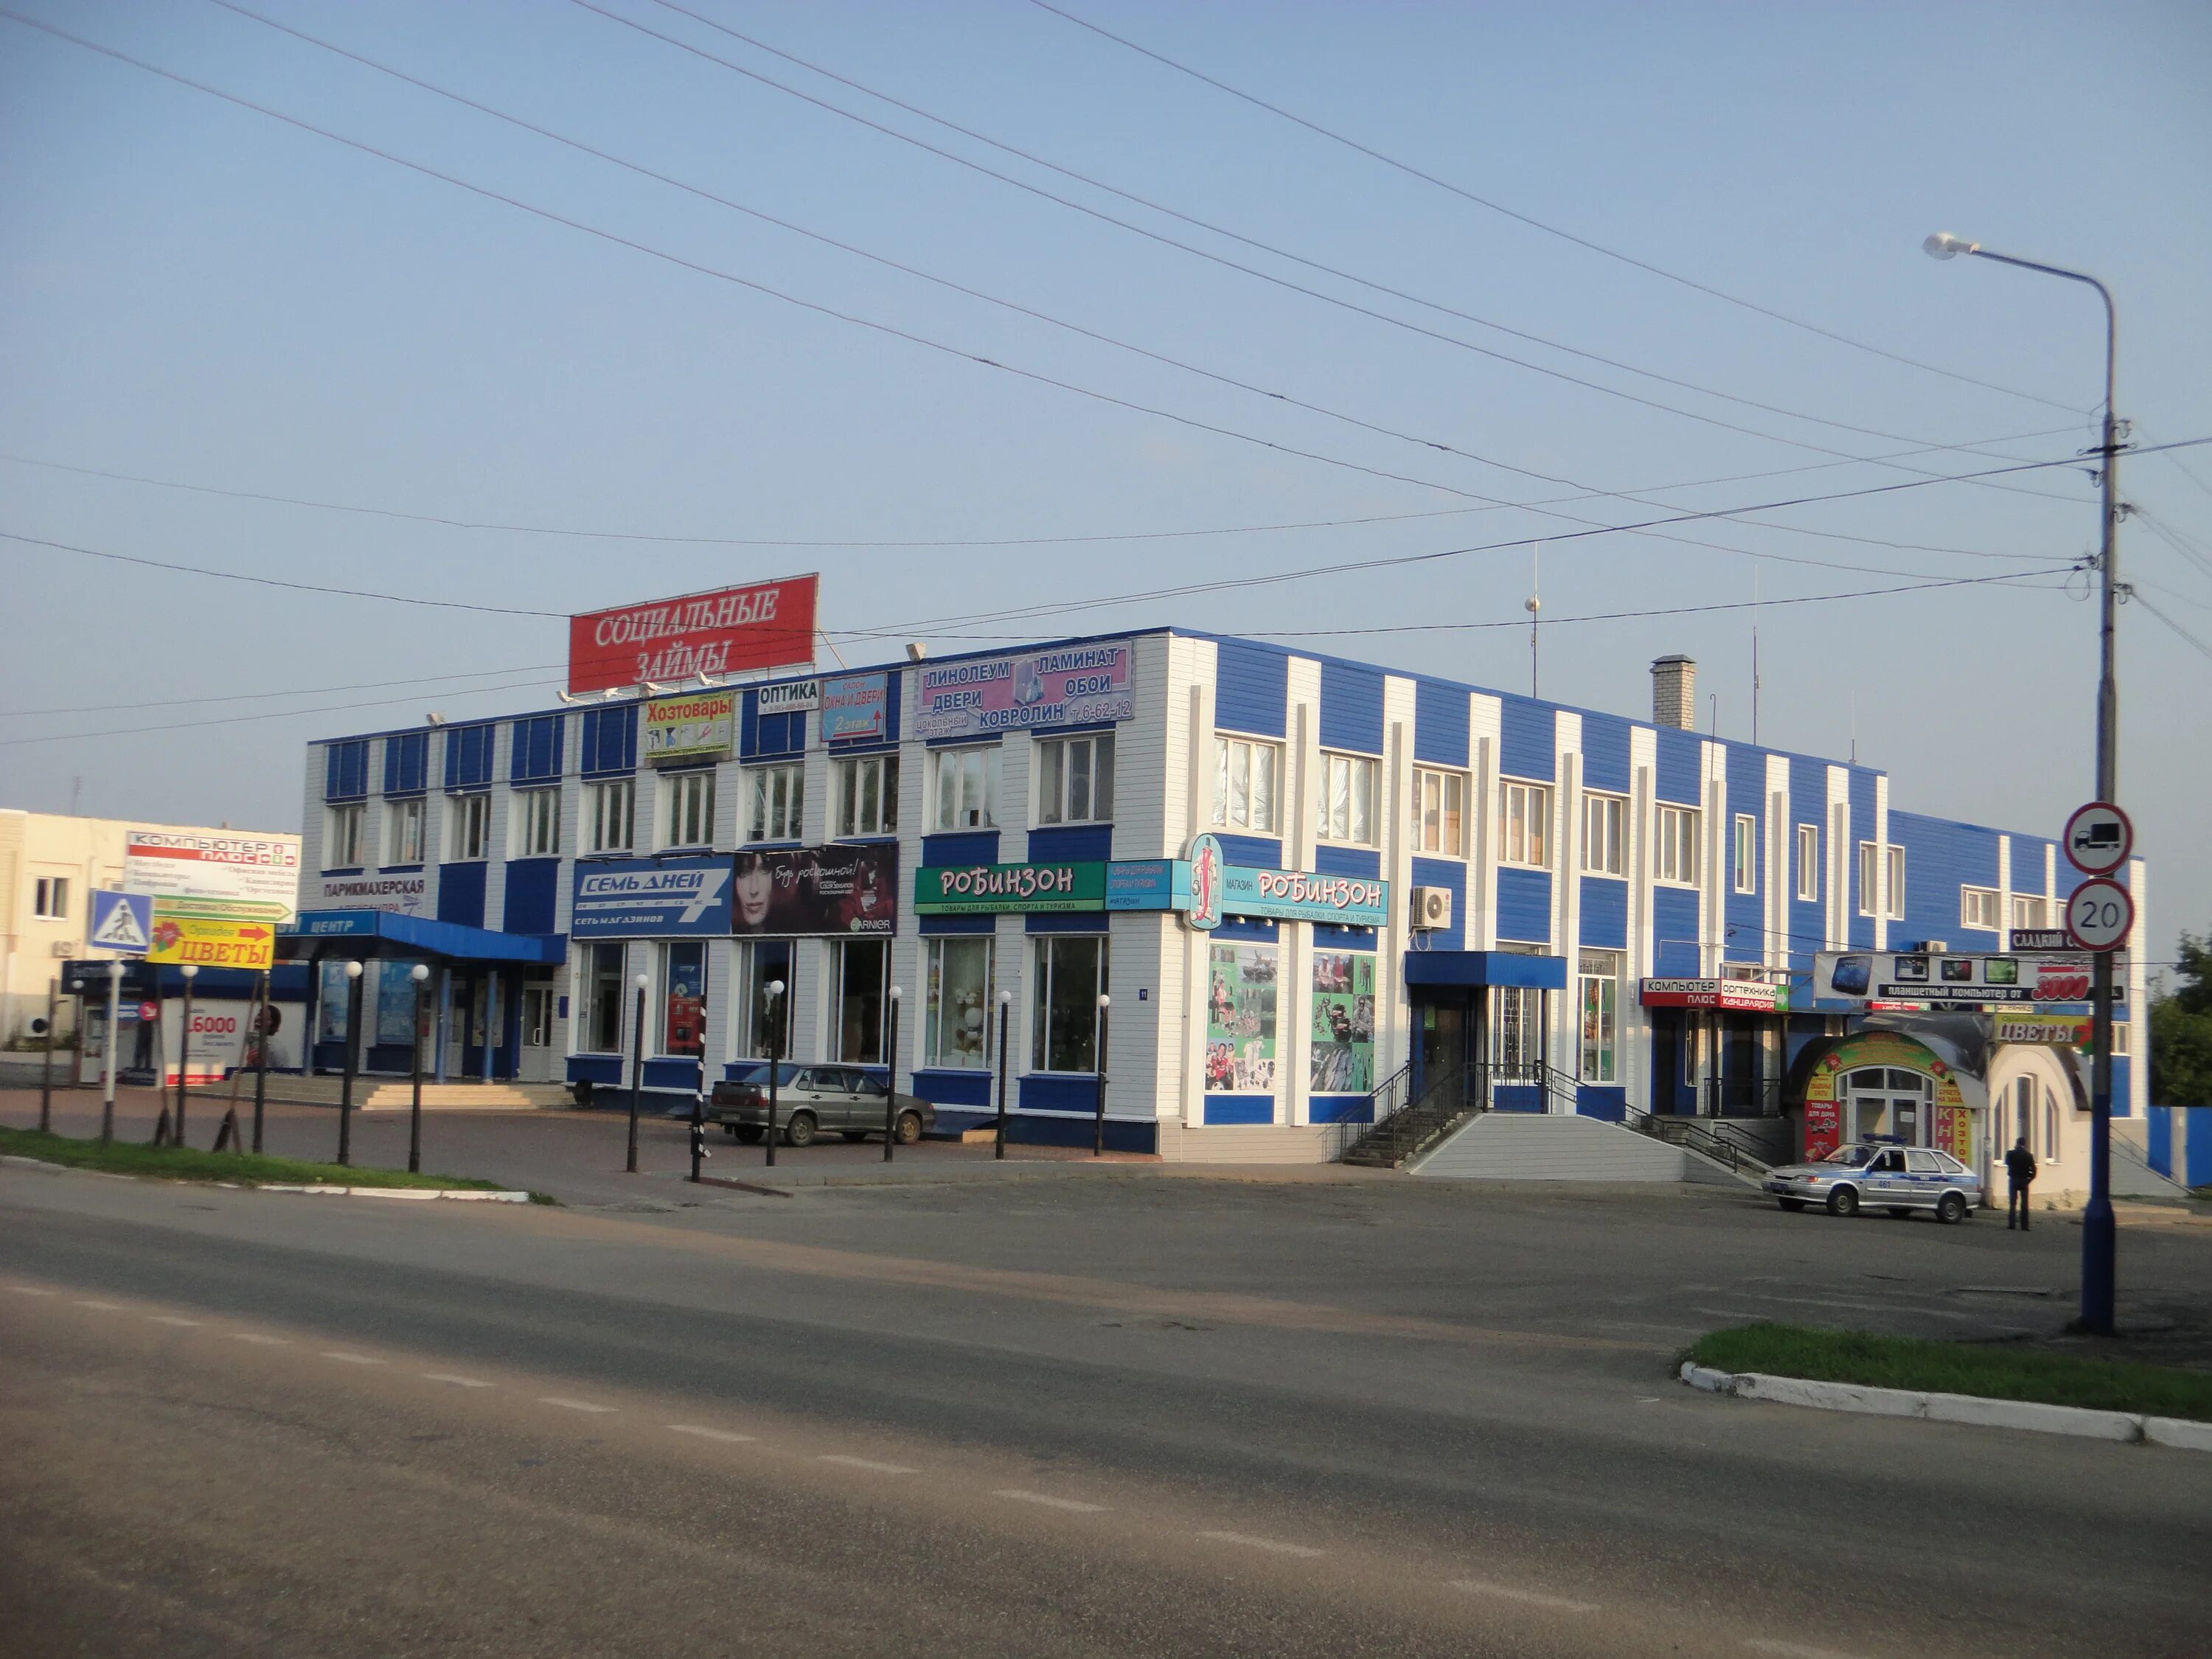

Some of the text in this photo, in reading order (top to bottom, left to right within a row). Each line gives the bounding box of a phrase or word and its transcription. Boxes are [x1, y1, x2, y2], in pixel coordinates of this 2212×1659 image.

[594, 589, 779, 647] СОЦИАЛЬНЫЕ
[633, 639, 732, 683] ЗАЙМЫ
[1037, 647, 1119, 674] ЛАМИНАТ
[926, 661, 1010, 688] ЛИНОЛЕУМ
[760, 682, 818, 704] ОПТИКА
[843, 681, 865, 690] САЛОН
[1065, 674, 1112, 697] ОБОИ
[824, 695, 845, 709] ОКНА
[847, 693, 854, 706] И
[855, 689, 884, 706] ДВЕРИ
[932, 689, 983, 714] ДВЕРИ
[647, 699, 731, 723] Хозтовары
[979, 703, 1065, 728] КОВРОЛИН
[835, 716, 869, 731] 2 этаж
[928, 726, 951, 737] этаж
[136, 834, 268, 851] КОМПЬЮТЕР
[200, 851, 255, 863] ПЛЮС
[586, 871, 705, 892] СЕМЬ ДНЕЙ
[775, 858, 860, 888] Будь роскошной!
[941, 866, 1073, 897] РОБИНЗОН
[324, 880, 425, 897] ПАРИКМАХЕРСКАЯ
[1226, 879, 1253, 891] МАГАЗИН
[1259, 871, 1381, 908] РОБИНЗОН
[599, 915, 664, 925] МАГАЗИНОВ
[1261, 907, 1284, 915] ТОВАРЫ
[1327, 912, 1349, 921] СПОРТА
[1356, 914, 1380, 923] ТУРИЗМА
[2080, 901, 2119, 928] 20
[311, 920, 354, 933] ЦЕНТР
[2013, 932, 2062, 947] СЛАДКИЙ
[179, 941, 270, 964] ЦВЕТЫ
[1648, 981, 1715, 992] КОМПЬЮТЕР
[1722, 984, 1775, 997] оргтехника
[1888, 986, 2023, 1000] планшетный компьютер от
[1688, 995, 1716, 1004] ПЛЮС
[1722, 997, 1775, 1009] канцелярия
[1997, 1023, 2074, 1042] ЦВЕТЫ
